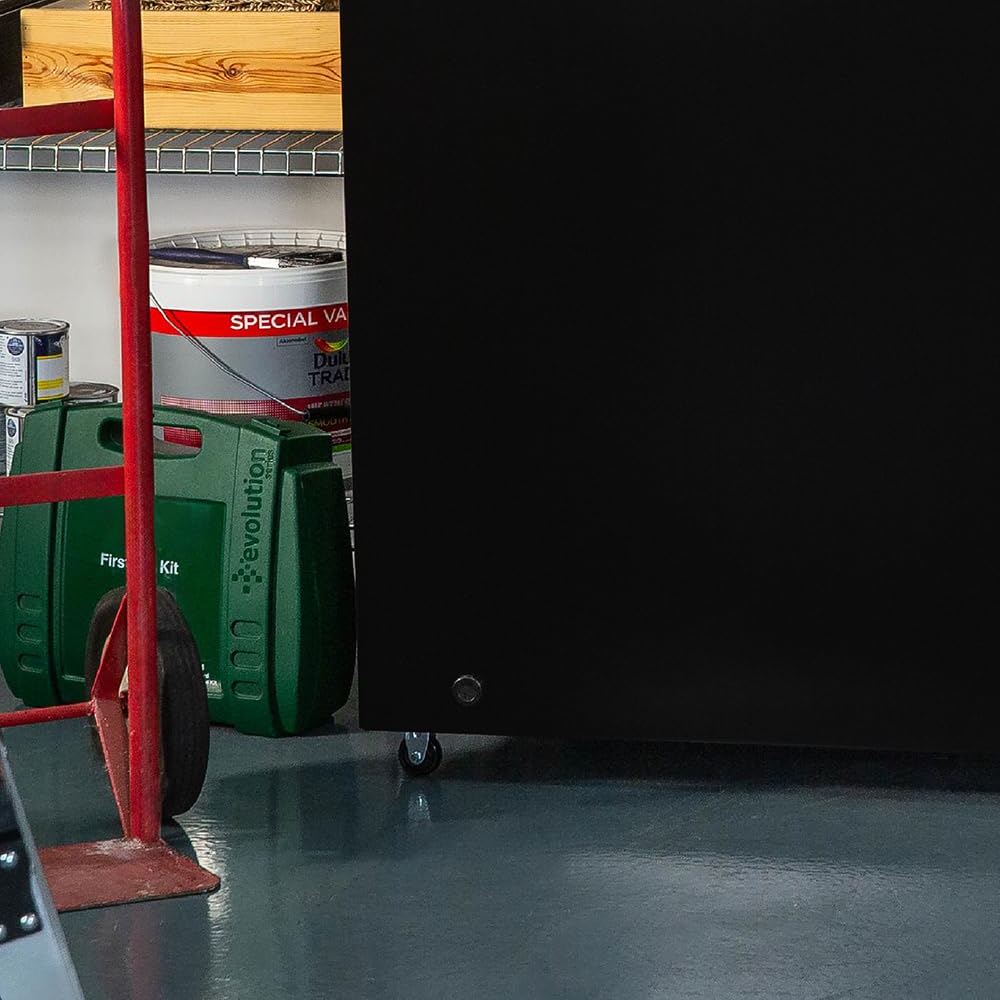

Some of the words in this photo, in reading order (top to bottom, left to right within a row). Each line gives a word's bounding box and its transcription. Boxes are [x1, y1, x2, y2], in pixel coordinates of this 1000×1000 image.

[230, 311, 318, 330] SPECIAL
[241, 448, 266, 562] evolution
[100, 552, 127, 569] Firs
[160, 560, 180, 575] Kit
